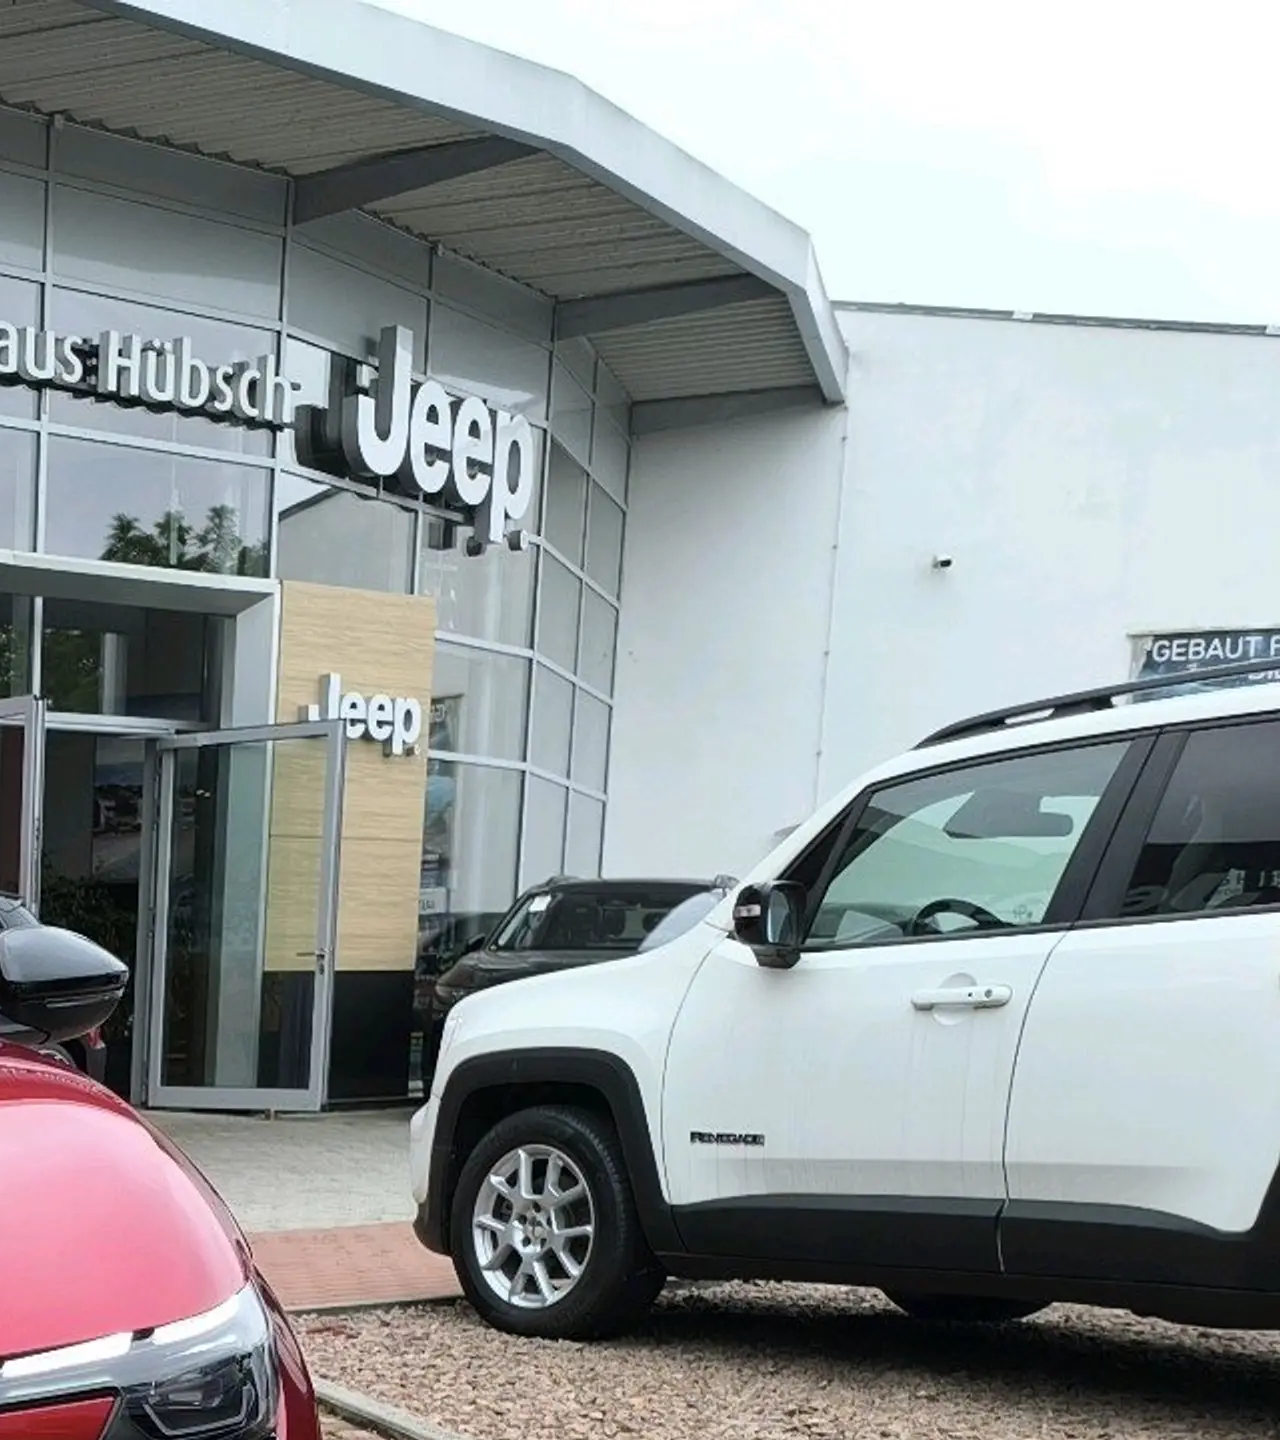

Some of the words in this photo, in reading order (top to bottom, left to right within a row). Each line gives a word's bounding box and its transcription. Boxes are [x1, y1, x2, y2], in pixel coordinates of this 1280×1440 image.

[106, 330, 296, 426] Hübsch
[355, 325, 534, 546] Jeep
[1152, 636, 1264, 663] GEBAUT
[308, 671, 422, 756] Jeep
